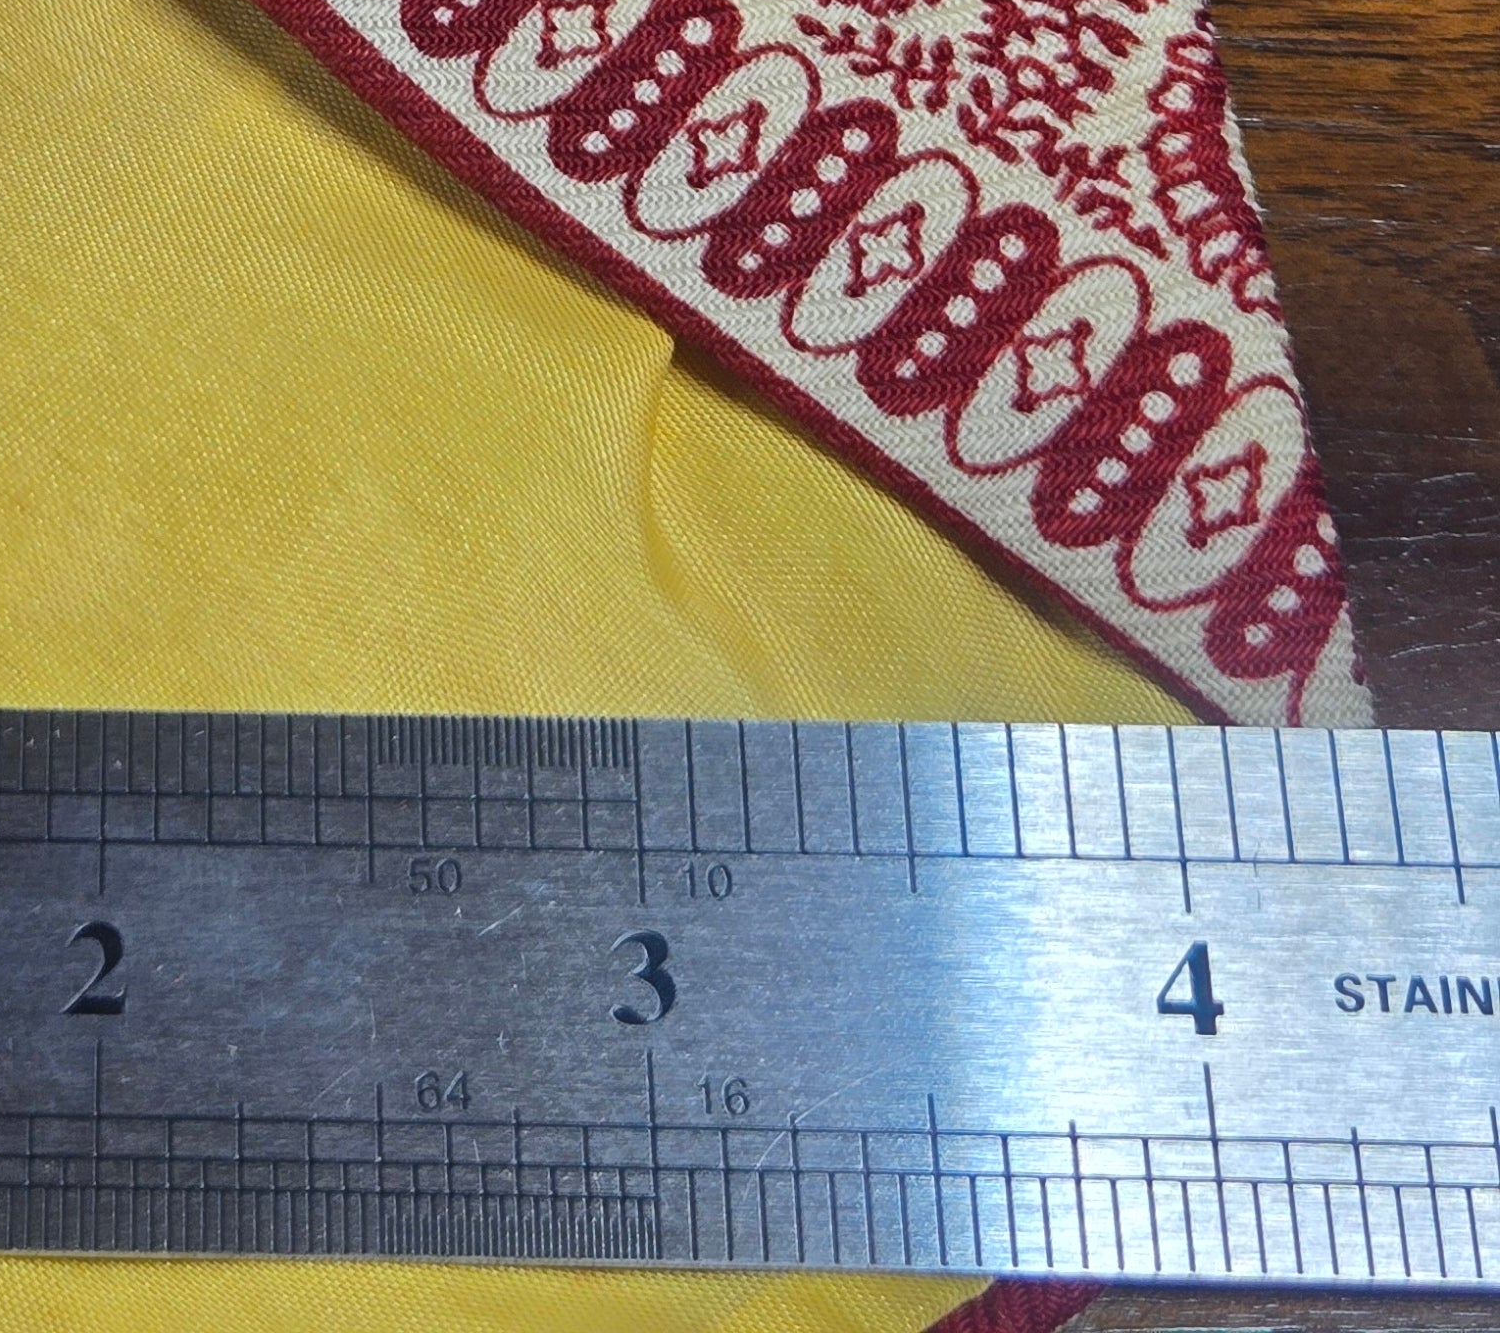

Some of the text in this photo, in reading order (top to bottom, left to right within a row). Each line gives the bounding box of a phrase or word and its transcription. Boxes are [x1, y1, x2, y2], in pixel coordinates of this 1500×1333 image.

[408, 858, 463, 895] 50
[681, 862, 734, 901] 10
[62, 920, 128, 1015] 2
[609, 929, 676, 1025] 3
[1157, 940, 1225, 1036] 4
[1333, 973, 1500, 1015] STAIN
[415, 1070, 472, 1111] 64
[699, 1076, 750, 1116] 16
